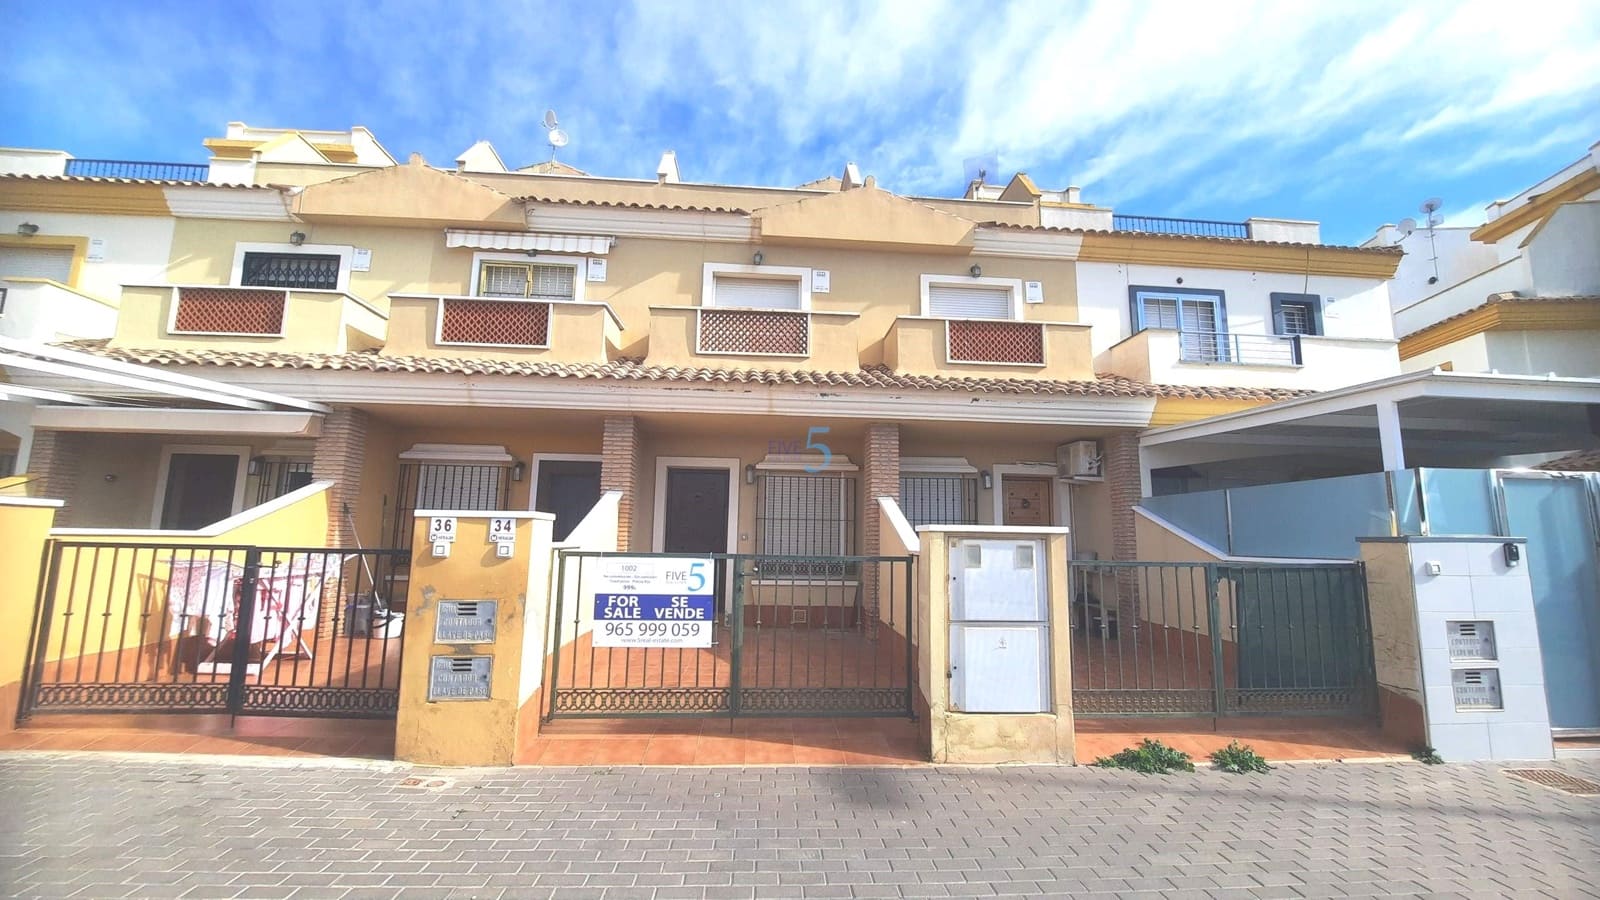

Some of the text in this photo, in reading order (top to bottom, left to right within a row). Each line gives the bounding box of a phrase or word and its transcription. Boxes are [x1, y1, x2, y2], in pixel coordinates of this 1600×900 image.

[434, 518, 452, 532] 36
[494, 519, 511, 533] 34
[622, 564, 637, 573] 1002
[665, 563, 706, 592] FIVE 5
[608, 595, 639, 608] FOR
[671, 596, 689, 608] SE
[604, 607, 642, 619] SALE
[654, 608, 705, 619] VENDE
[605, 622, 700, 637] 965 999 059
